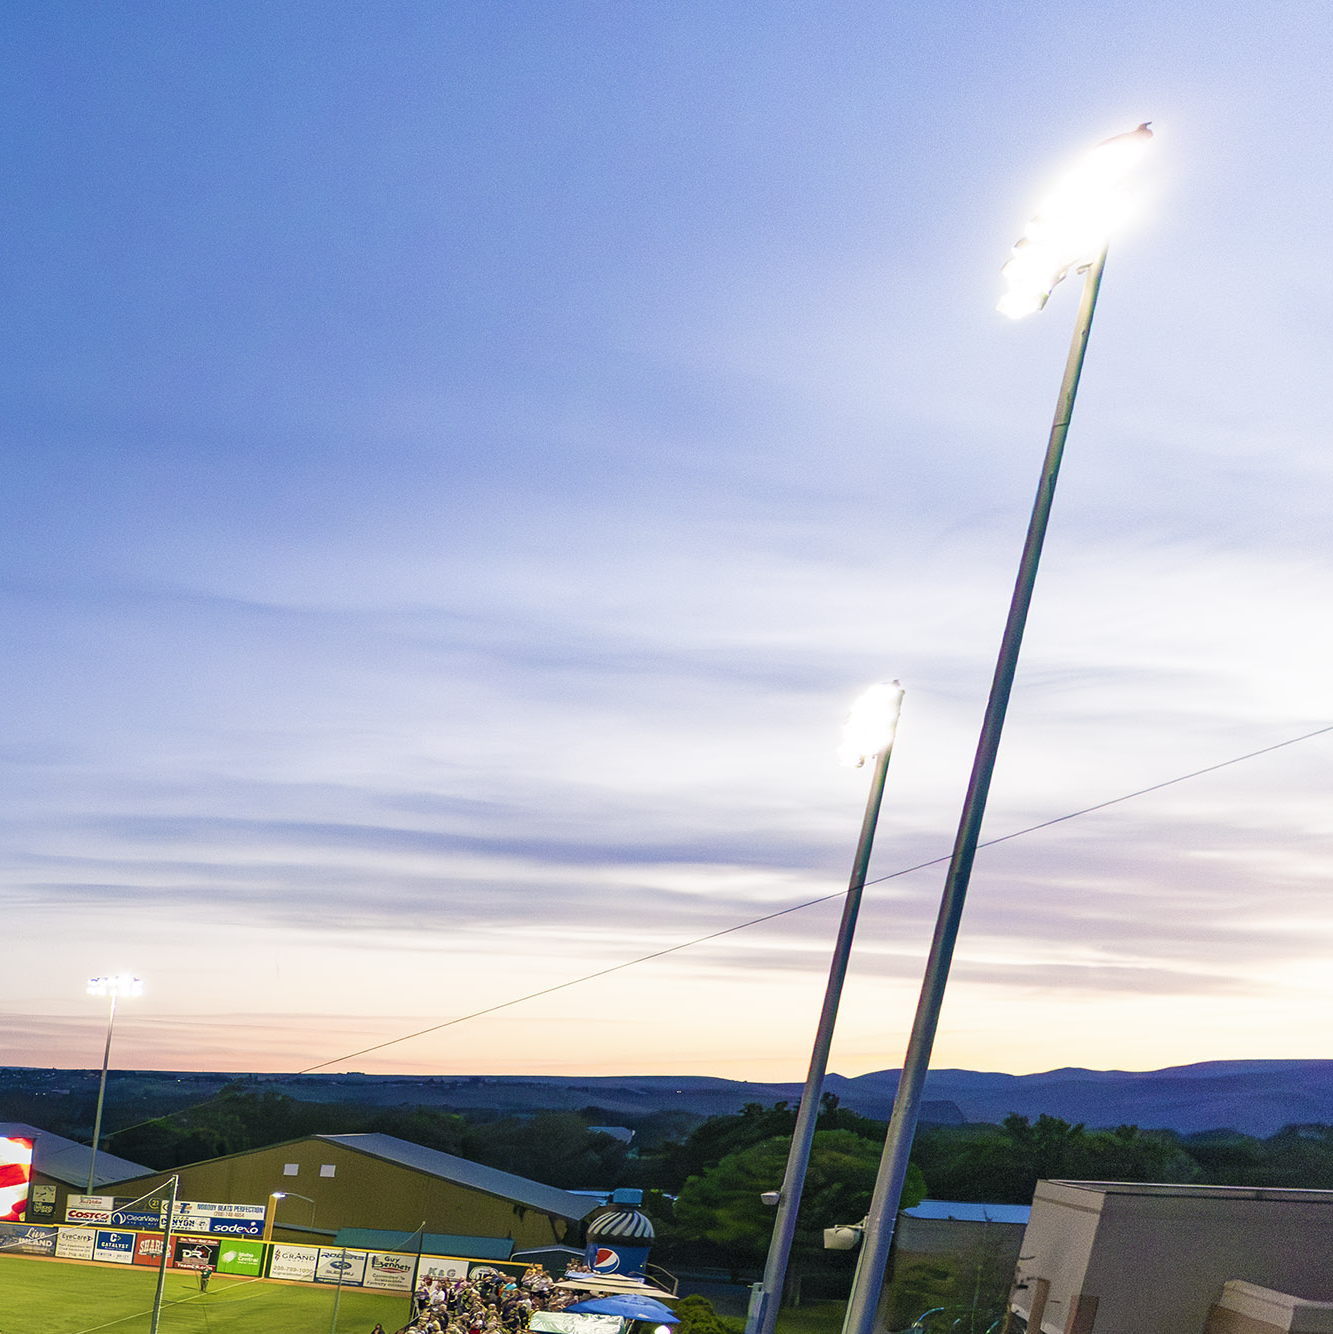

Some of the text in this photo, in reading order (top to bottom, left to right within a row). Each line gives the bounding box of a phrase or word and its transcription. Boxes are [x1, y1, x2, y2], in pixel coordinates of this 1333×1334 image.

[233, 1205, 263, 1213] PERFECTION
[68, 1210, 109, 1219] COSTCO
[25, 1227, 46, 1239] Live
[213, 1224, 259, 1234] sodexo
[428, 1267, 436, 1275] K
[447, 1268, 456, 1277] G
